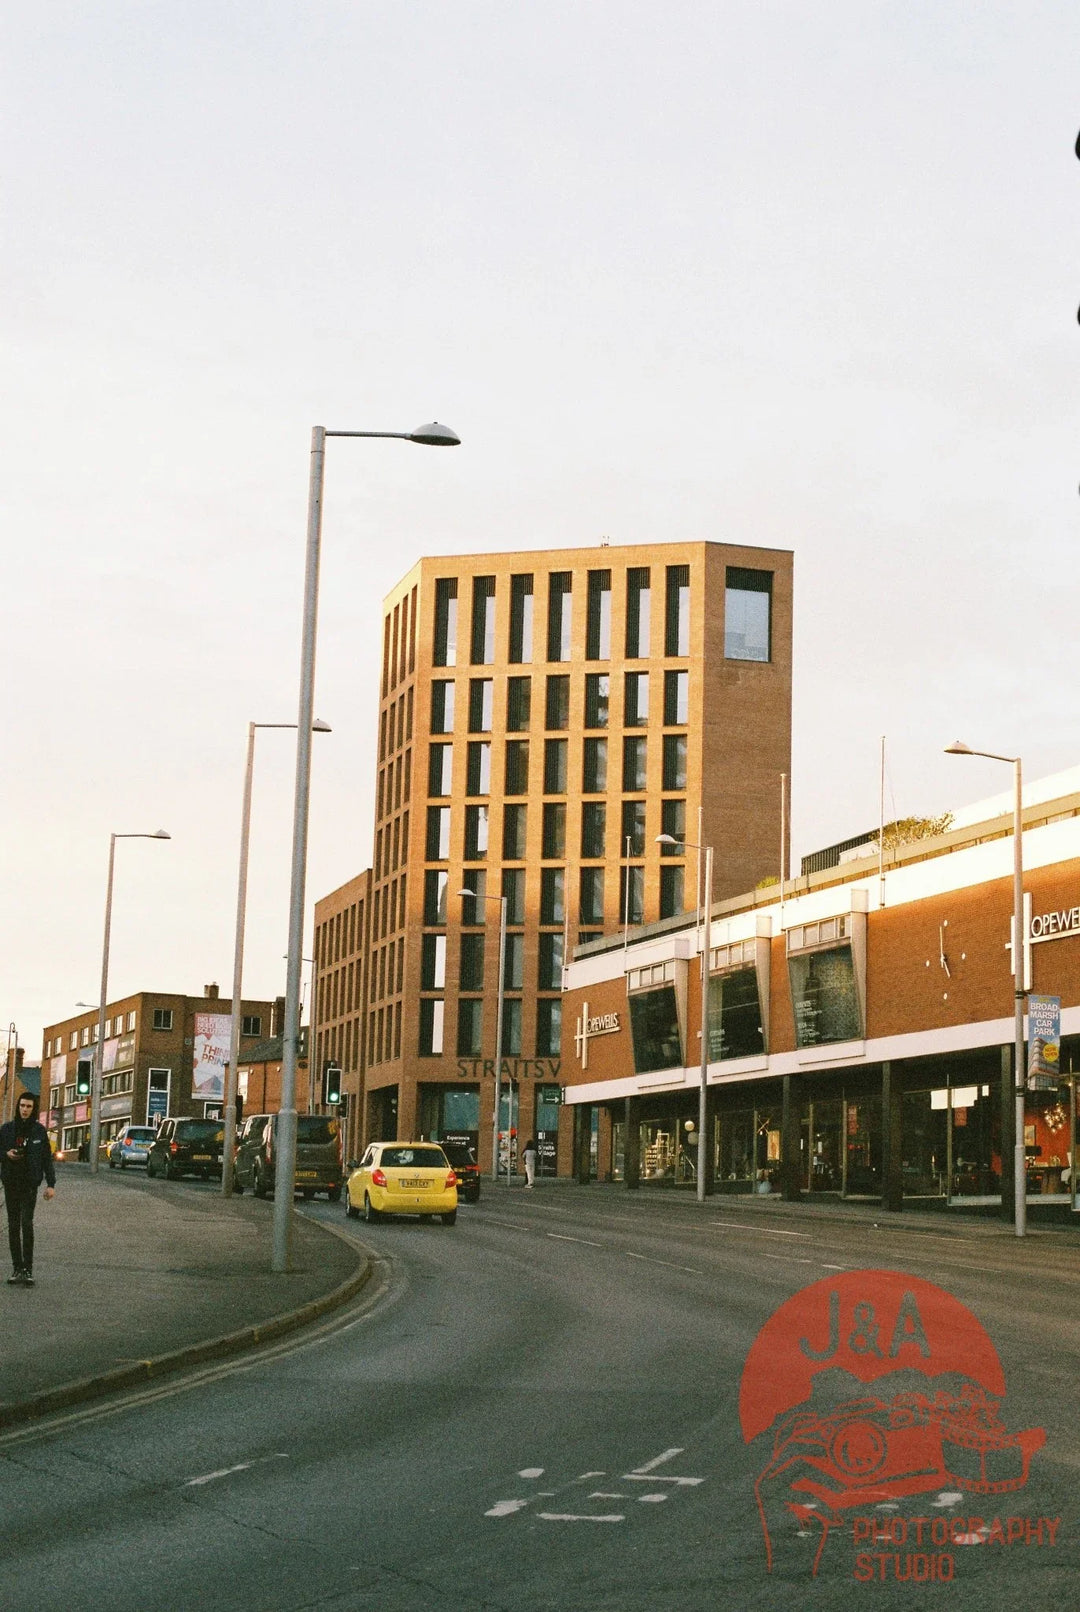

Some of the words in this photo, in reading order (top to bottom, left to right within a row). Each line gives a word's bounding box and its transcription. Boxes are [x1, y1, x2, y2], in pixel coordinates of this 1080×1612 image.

[1030, 1011, 1058, 1020] MARSH
[1036, 1019, 1053, 1027] CAR
[1034, 1027, 1055, 1035] PARK
